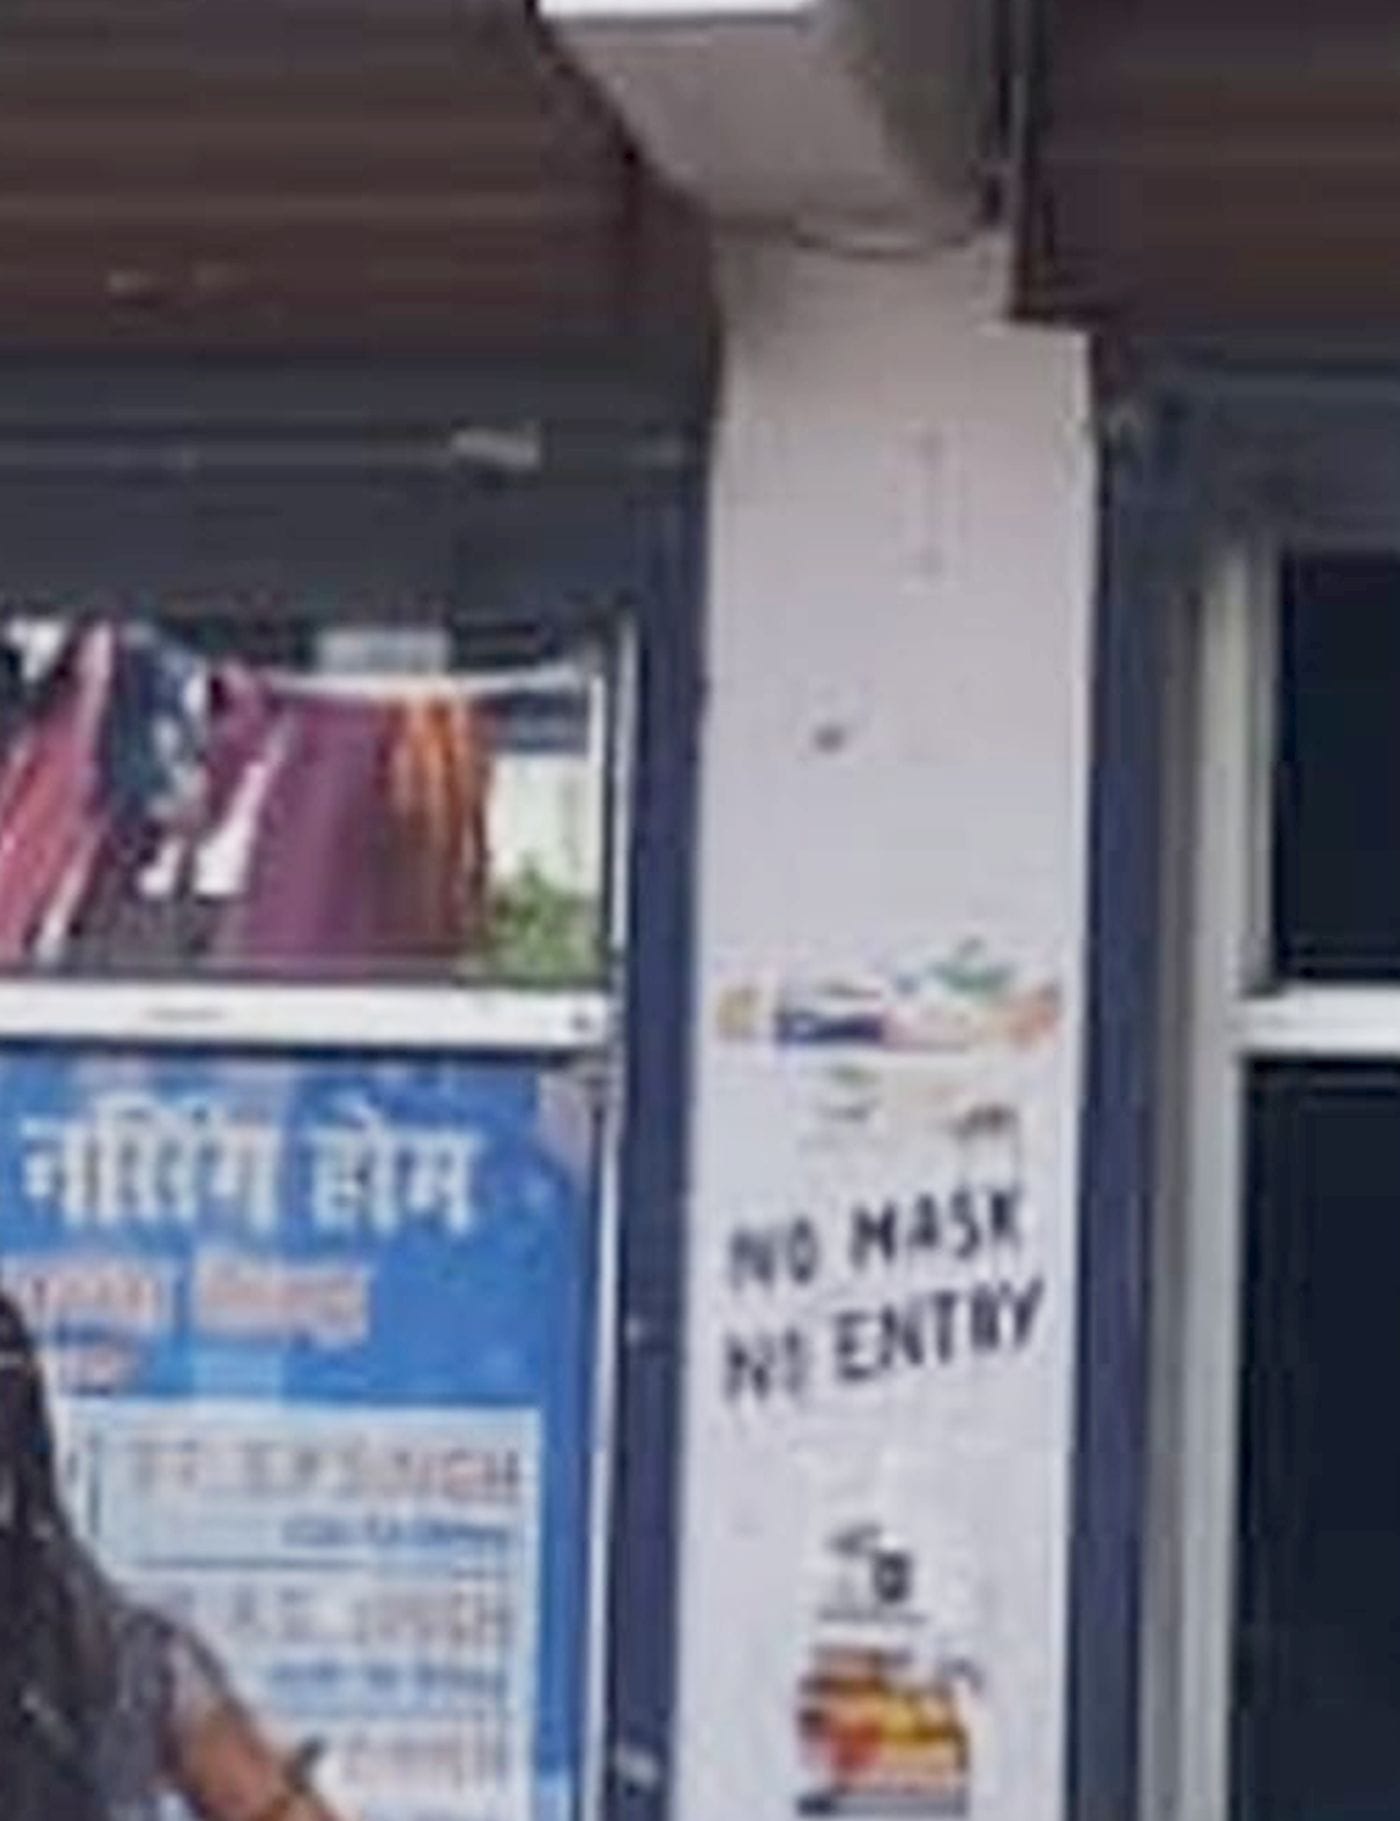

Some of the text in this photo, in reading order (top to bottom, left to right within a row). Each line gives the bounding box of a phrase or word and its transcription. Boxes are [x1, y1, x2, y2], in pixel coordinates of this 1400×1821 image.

[300, 1088, 488, 1236] होम
[728, 1184, 1022, 1294] NO MASK
[830, 1276, 1044, 1386] ENTRY
